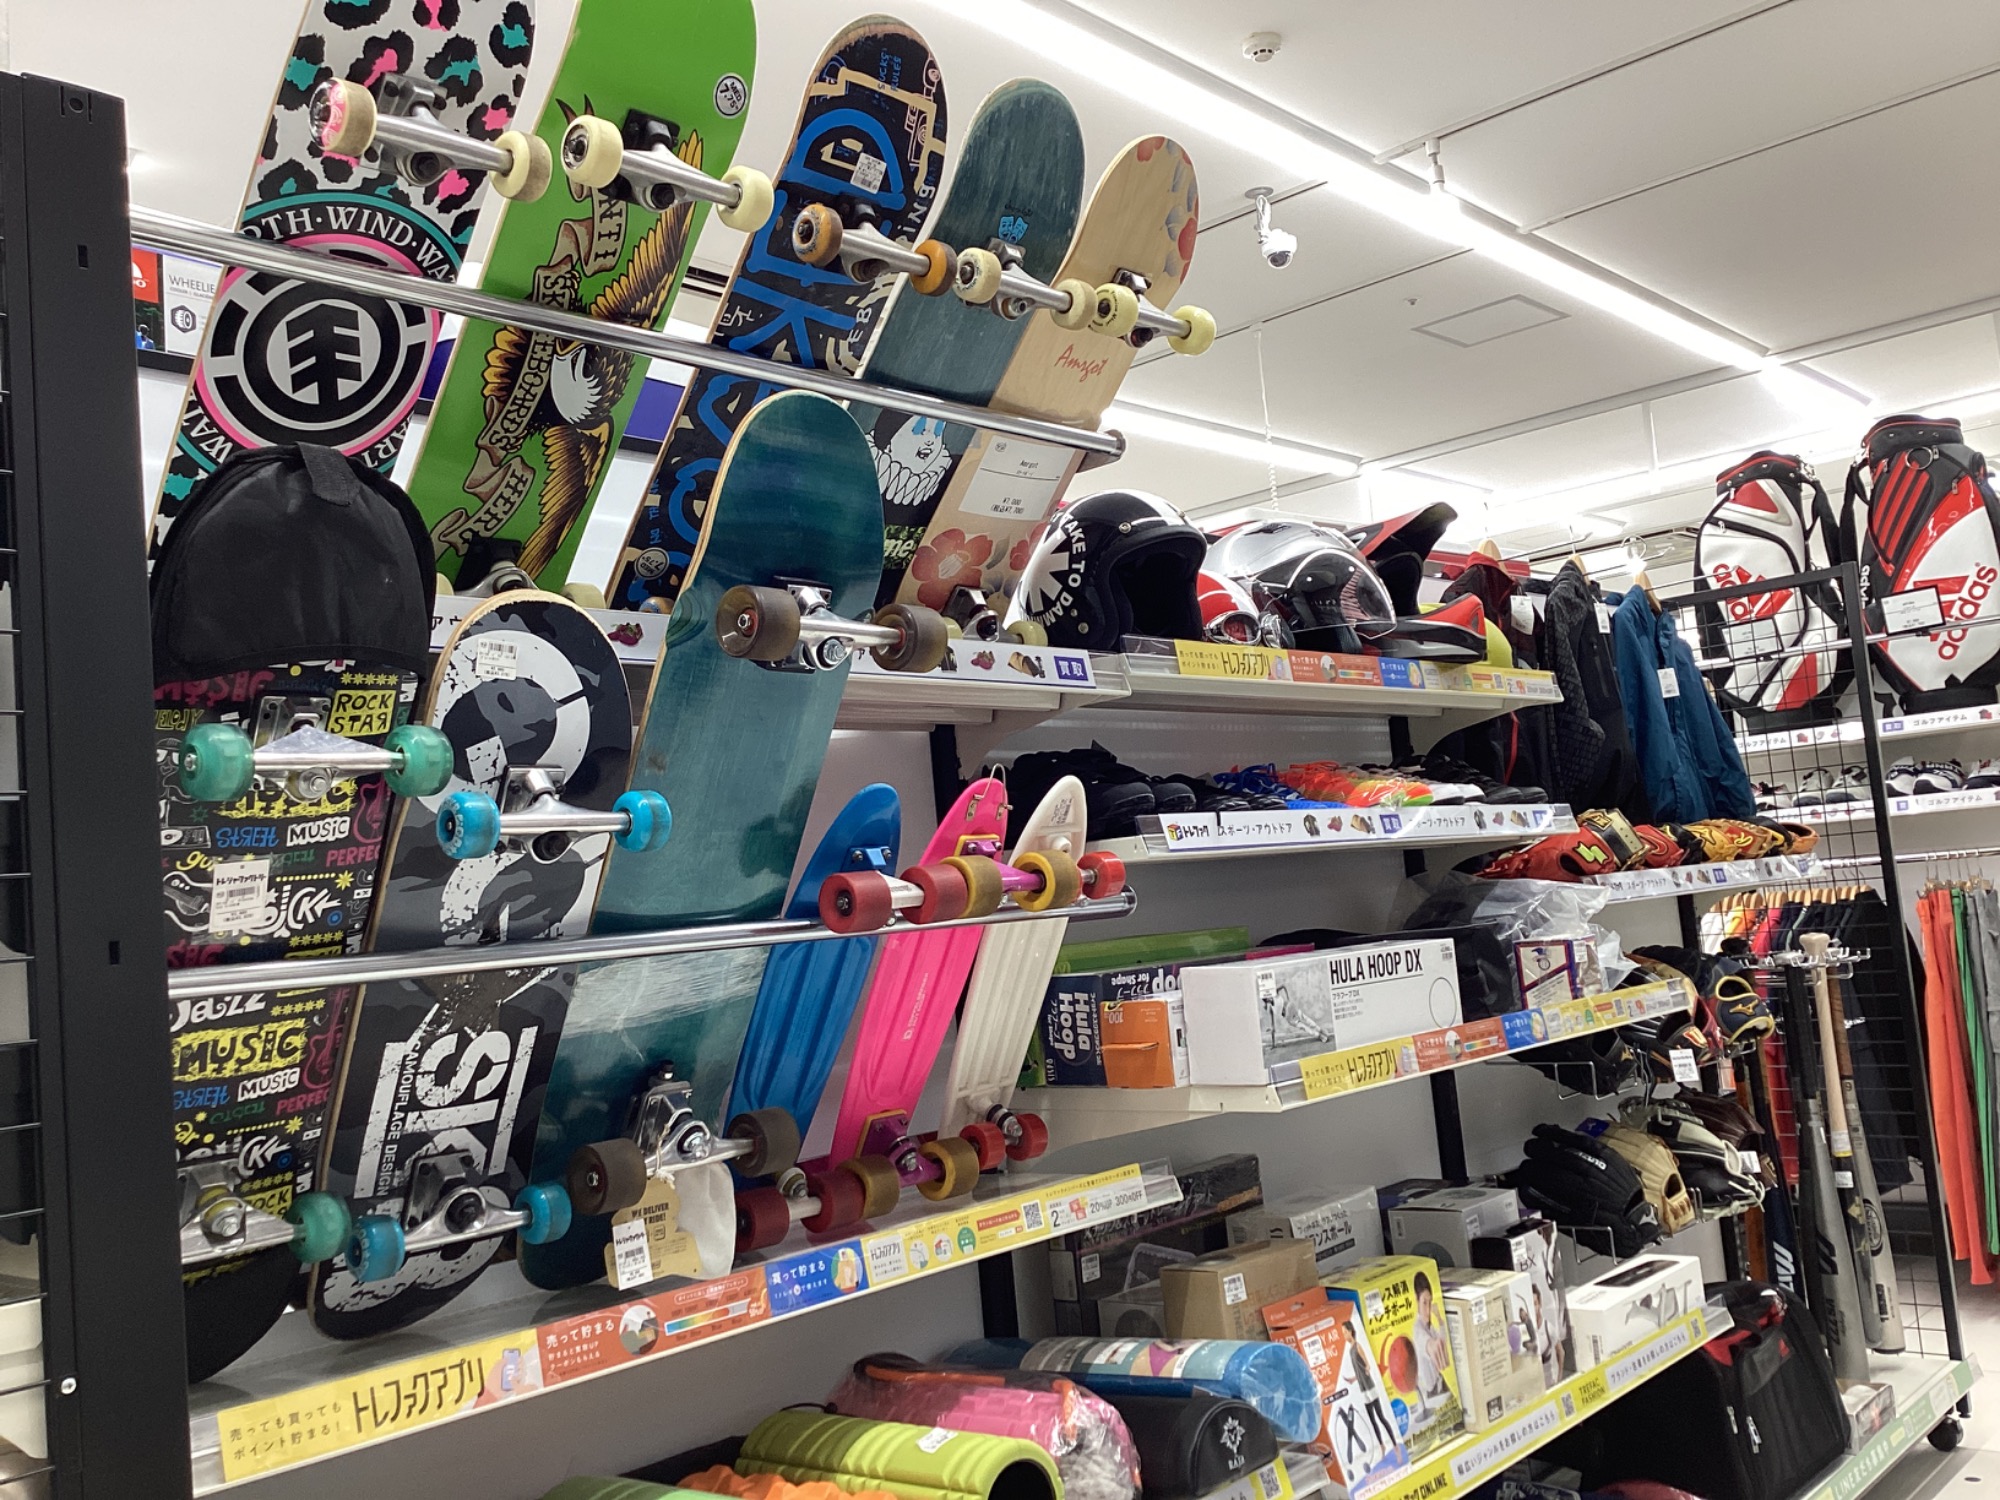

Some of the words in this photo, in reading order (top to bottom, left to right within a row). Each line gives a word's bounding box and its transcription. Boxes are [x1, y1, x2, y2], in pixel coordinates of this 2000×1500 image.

[1067, 560, 1086, 588] TO
[1058, 657, 1086, 679] 買取
[1221, 651, 1273, 677] トレファクアプリ
[336, 691, 393, 712] ROCK
[330, 714, 389, 735] STAR
[1329, 955, 1366, 986] HULA
[1367, 951, 1402, 980] HOOP
[1405, 947, 1424, 974] DX
[1054, 992, 1075, 1060] Hoop
[1074, 992, 1093, 1051] Hula
[173, 1024, 305, 1079] MUSIC
[1347, 1047, 1399, 1085] トレファクアプリ
[387, 1040, 422, 1141] CAMOUFLAGE
[376, 1144, 398, 1197] DESIGN
[643, 1201, 670, 1216] DELIVER
[1050, 1209, 1061, 1229] 2
[771, 1260, 827, 1286] 買って貯まる
[545, 1319, 616, 1351] 売って貯まる
[352, 1357, 486, 1436] トレファクアプリ
[1581, 1387, 1607, 1407] FASHION
[229, 1401, 343, 1443] 売っても買っても
